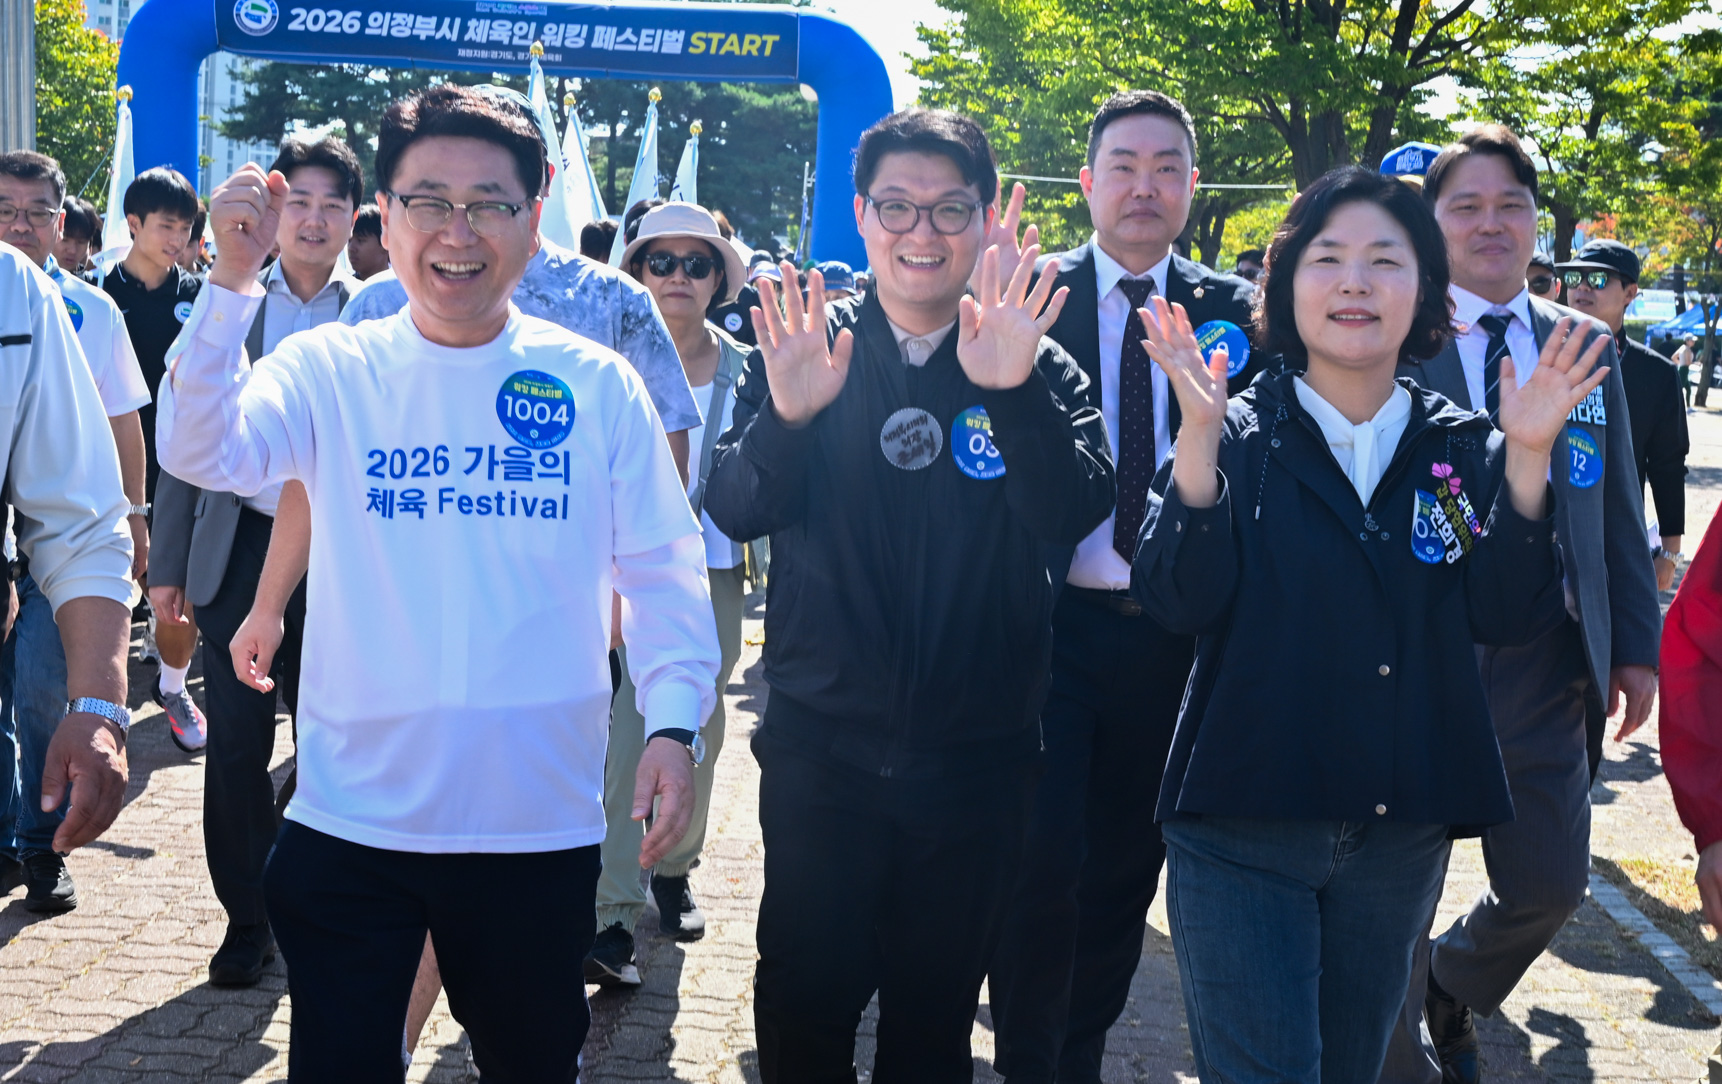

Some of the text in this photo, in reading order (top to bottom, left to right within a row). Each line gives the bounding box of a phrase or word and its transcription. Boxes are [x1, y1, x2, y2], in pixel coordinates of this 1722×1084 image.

[287, 7, 780, 57] 2026 의정부시 체육인 워킹 페스티벌 START
[531, 386, 563, 399] 페스티벌
[504, 395, 570, 426] 1004
[366, 444, 571, 486] 2026 가을의
[1572, 449, 1587, 472] 12
[366, 486, 569, 520] 체육 Festival
[1430, 501, 1463, 565] 전희경
